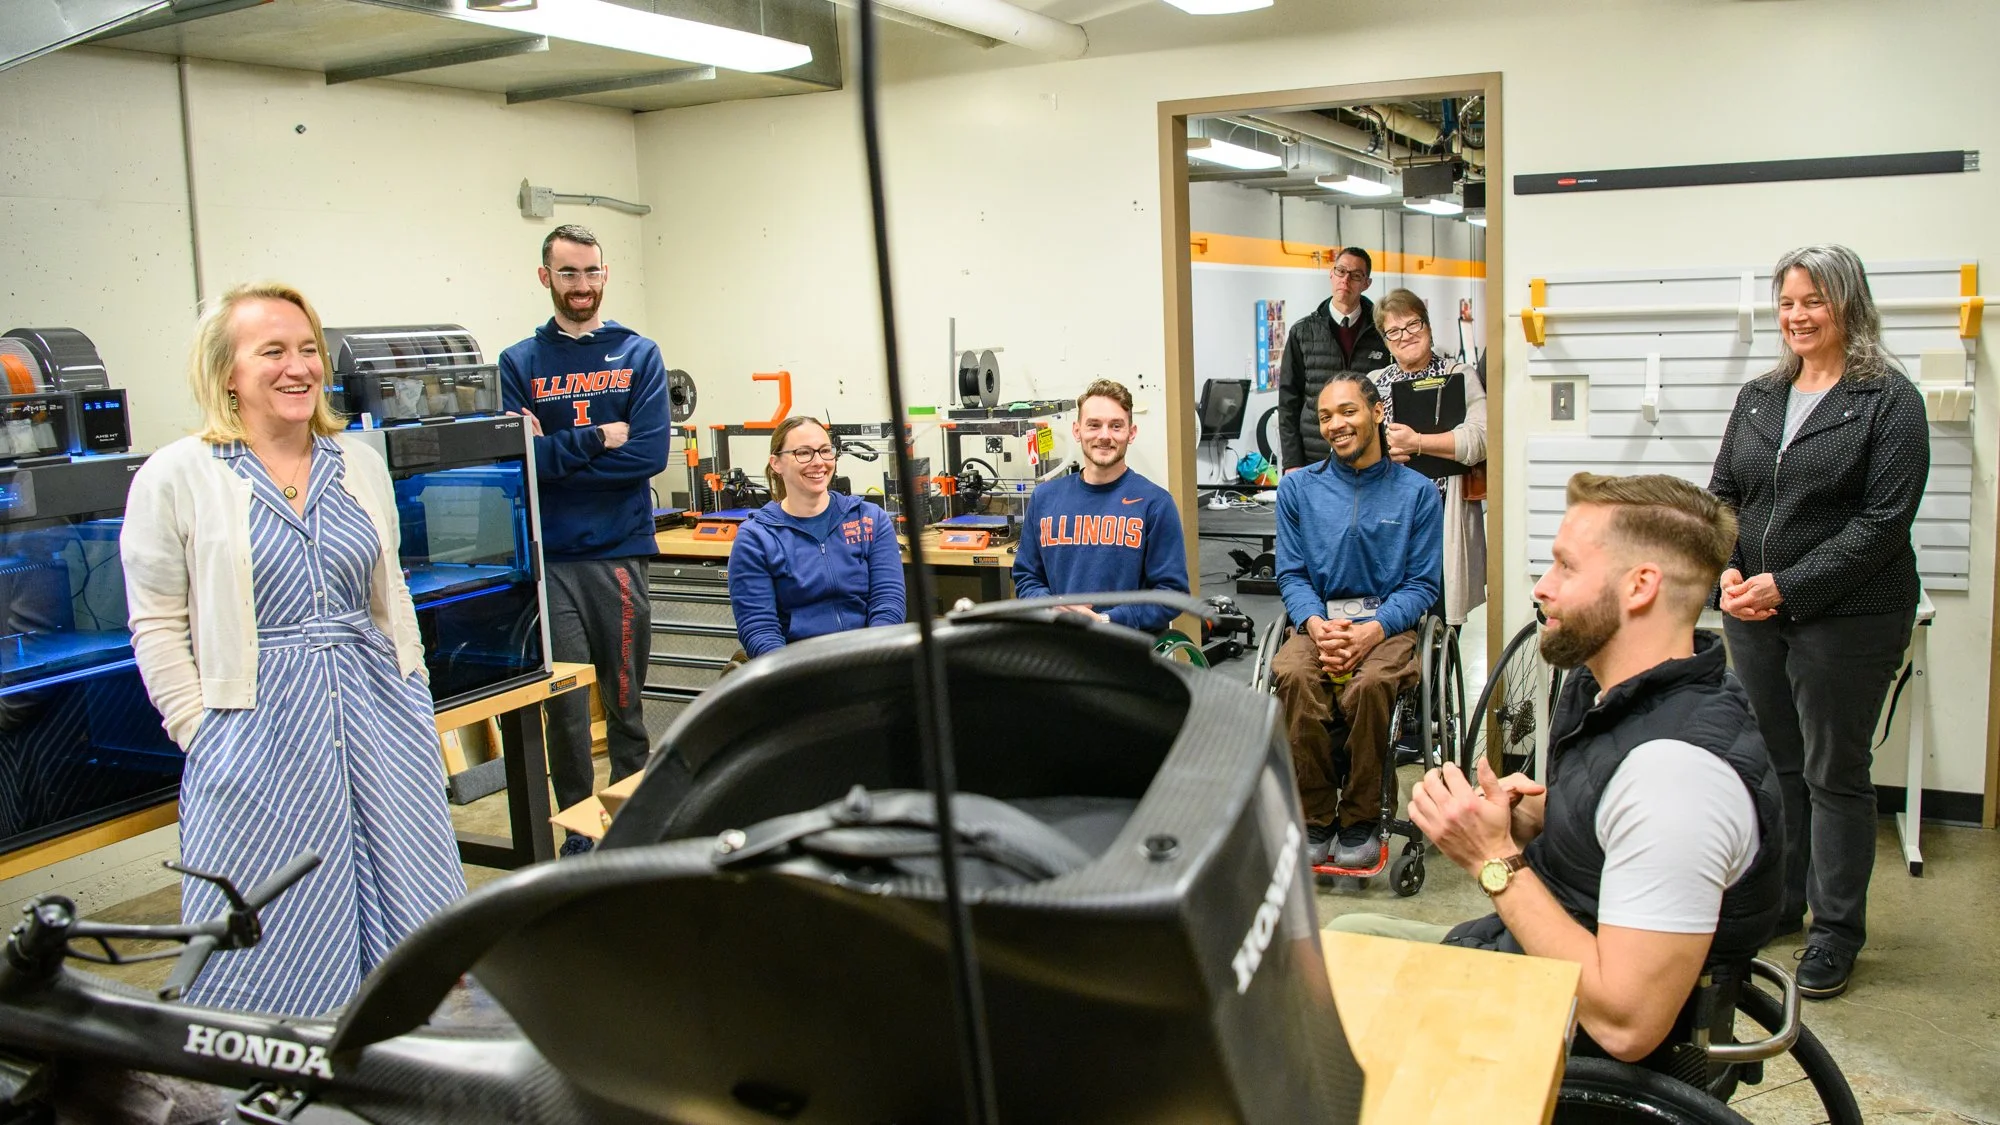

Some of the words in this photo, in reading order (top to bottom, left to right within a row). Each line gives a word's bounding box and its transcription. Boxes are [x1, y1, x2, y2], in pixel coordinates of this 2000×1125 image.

[531, 368, 634, 399] ILLINOIS
[573, 400, 591, 427] I
[1040, 515, 1144, 549] ILLINOIS
[1231, 820, 1300, 995] HONDA
[183, 1023, 335, 1080] HONDA
